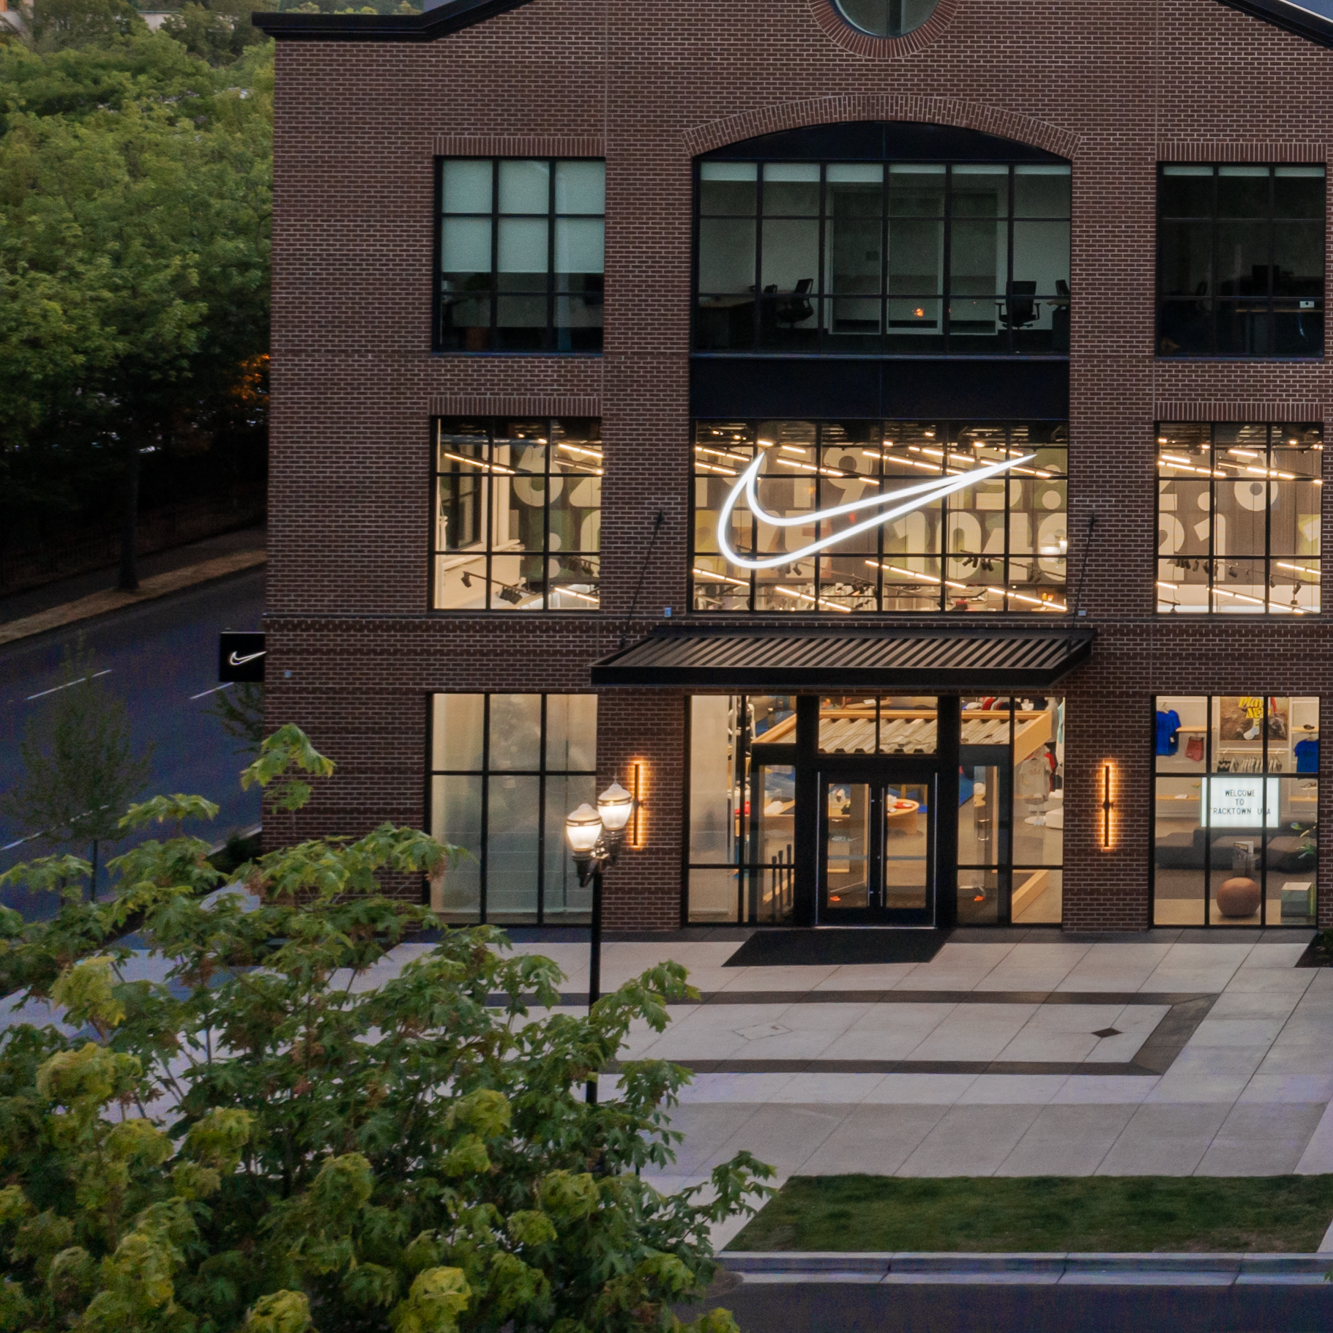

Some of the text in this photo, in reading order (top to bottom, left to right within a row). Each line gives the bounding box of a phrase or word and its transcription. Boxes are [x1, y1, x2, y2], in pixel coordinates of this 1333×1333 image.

[1225, 789, 1256, 797] WELCOME
[1235, 798, 1245, 806] TO
[1257, 807, 1271, 815] UA
